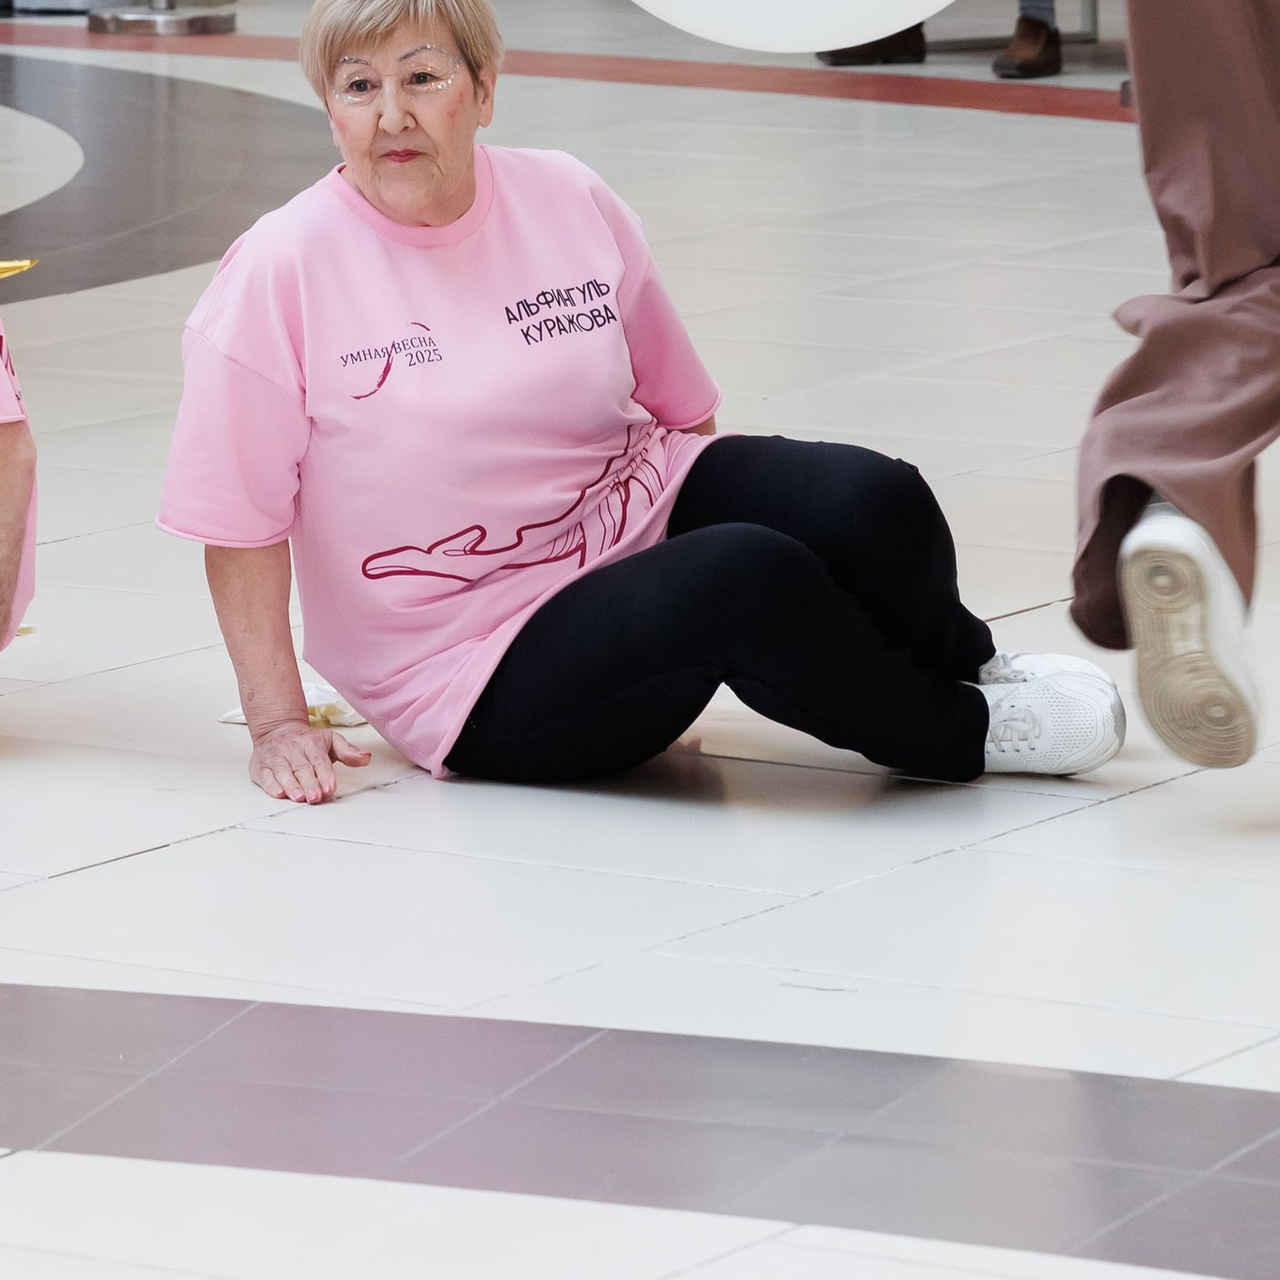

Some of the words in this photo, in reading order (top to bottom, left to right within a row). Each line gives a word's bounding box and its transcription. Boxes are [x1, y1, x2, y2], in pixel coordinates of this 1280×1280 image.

[340, 346, 390, 368] УМНАЯ
[393, 336, 437, 355] ВЕСНА
[404, 348, 443, 367] 2025
